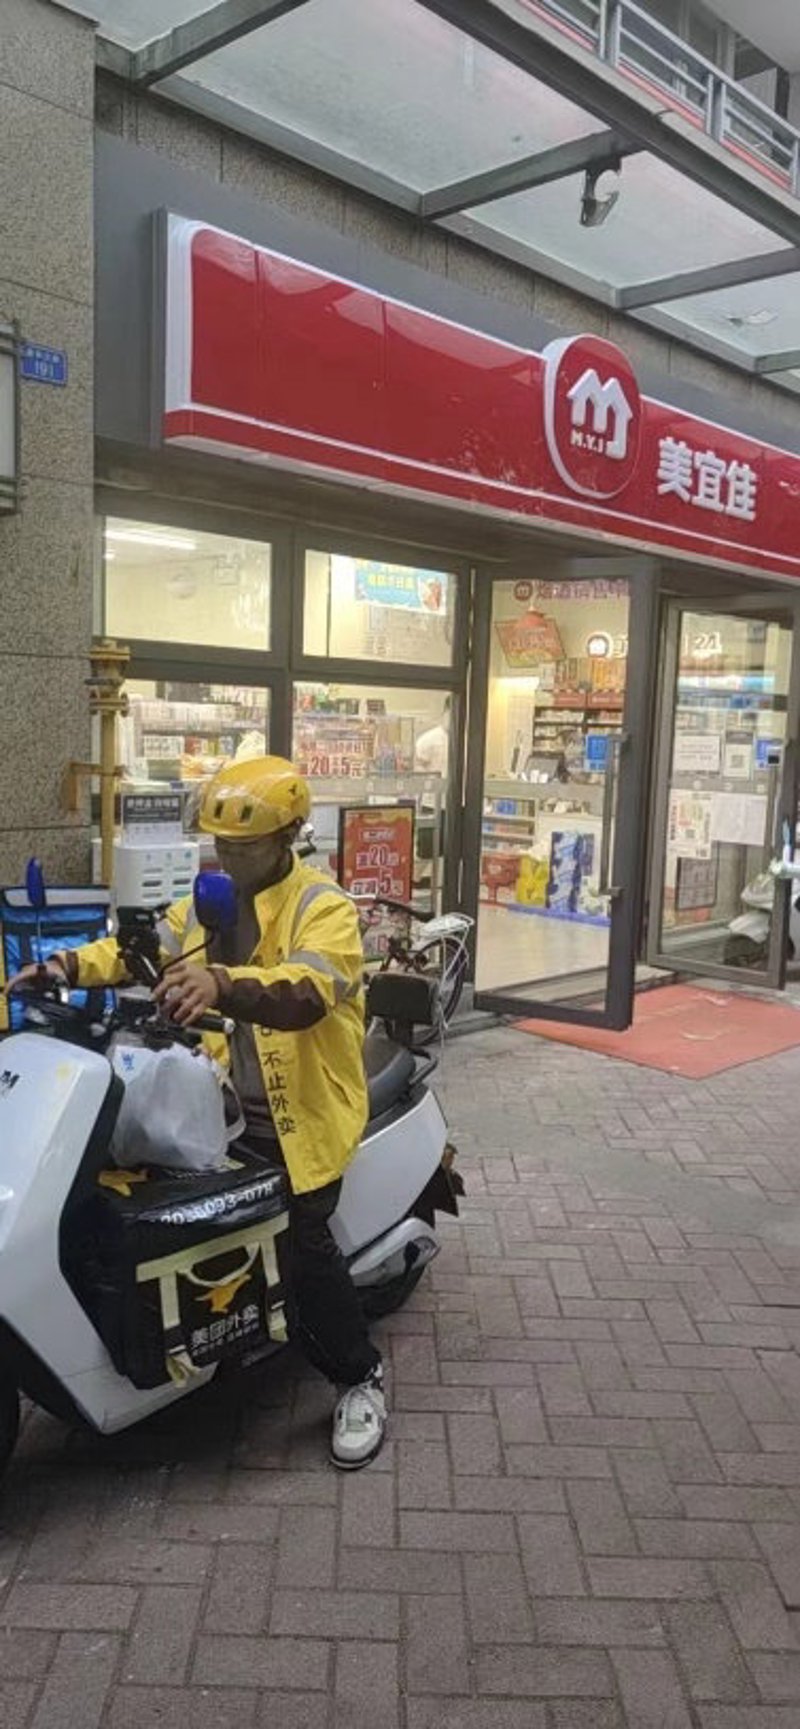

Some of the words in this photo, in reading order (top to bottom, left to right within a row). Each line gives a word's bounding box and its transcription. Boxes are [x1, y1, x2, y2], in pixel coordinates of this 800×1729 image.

[656, 436, 757, 523] 美宜佳
[261, 1050, 298, 1136] 不止外卖
[191, 1303, 259, 1348] 美团外卖
